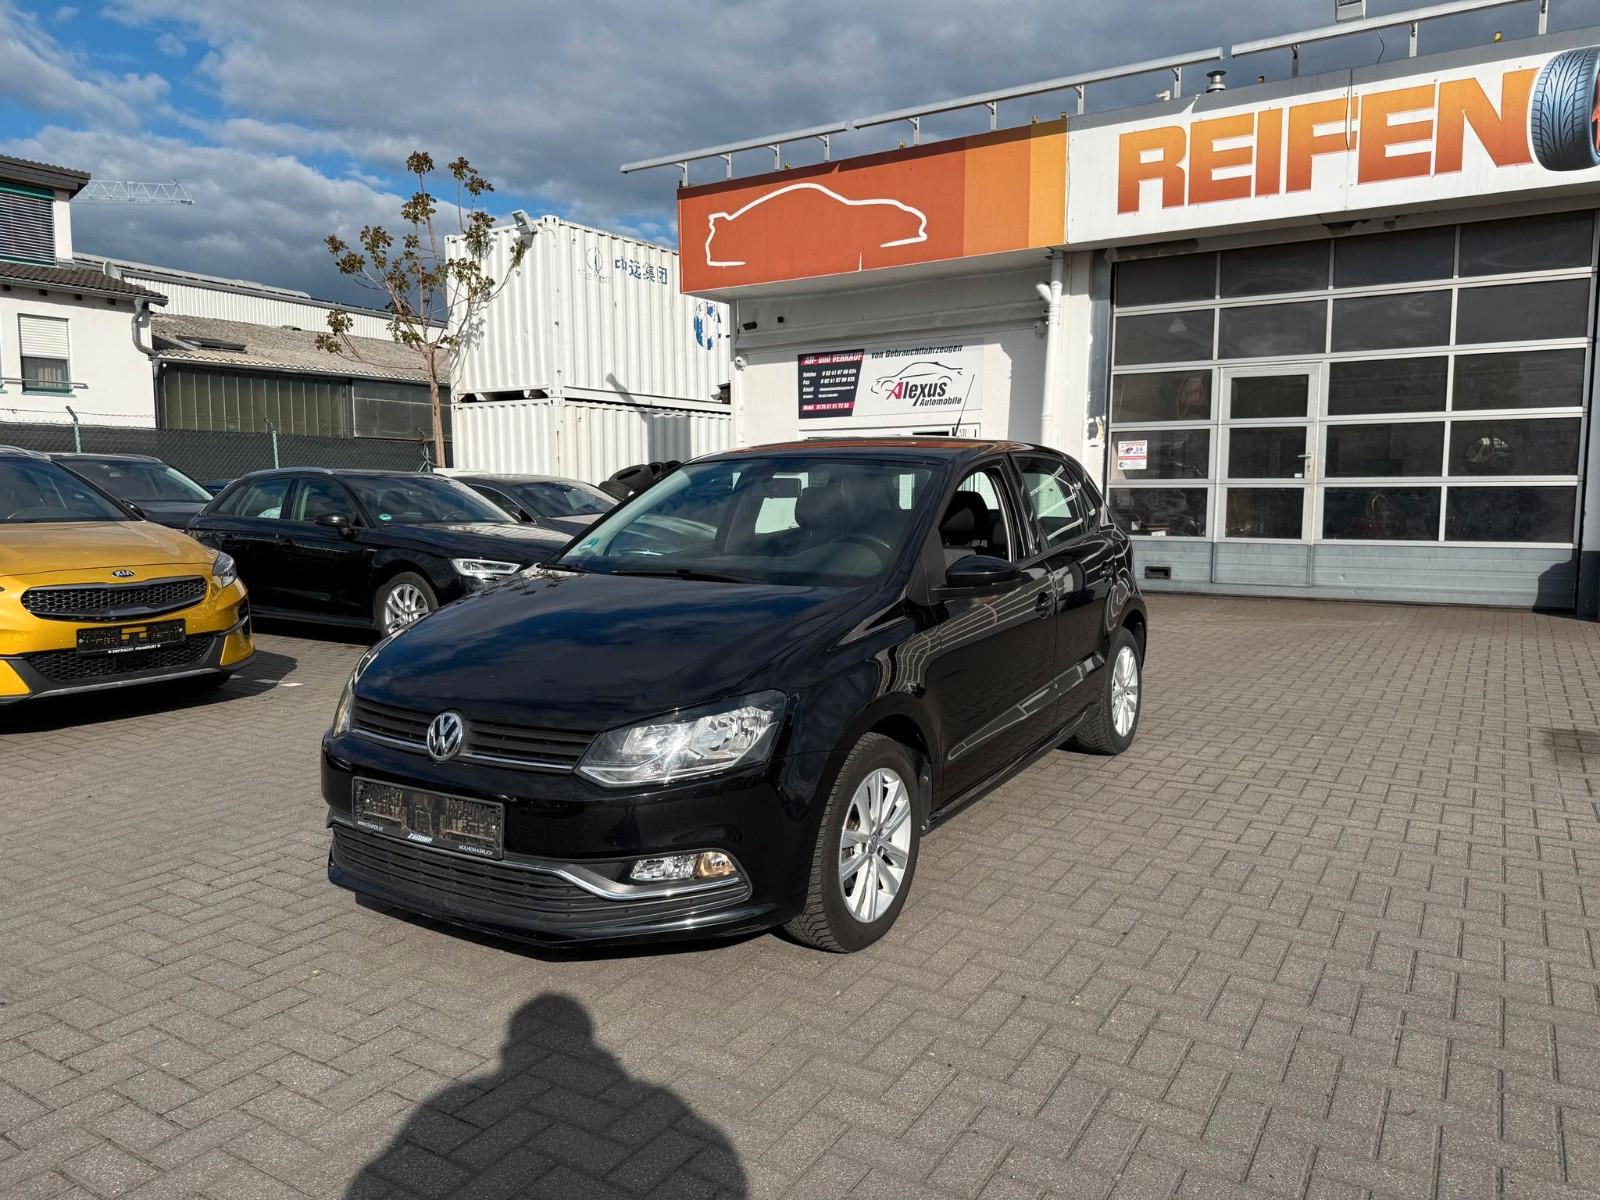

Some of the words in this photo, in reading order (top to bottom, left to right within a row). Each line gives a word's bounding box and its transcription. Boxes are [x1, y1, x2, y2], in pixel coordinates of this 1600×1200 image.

[1117, 68, 1539, 215] REIFEN
[871, 351, 884, 359] von
[885, 344, 963, 358] Gebrauchtfahrzeugen
[886, 381, 948, 407] Alexus
[919, 396, 962, 407] Automobile
